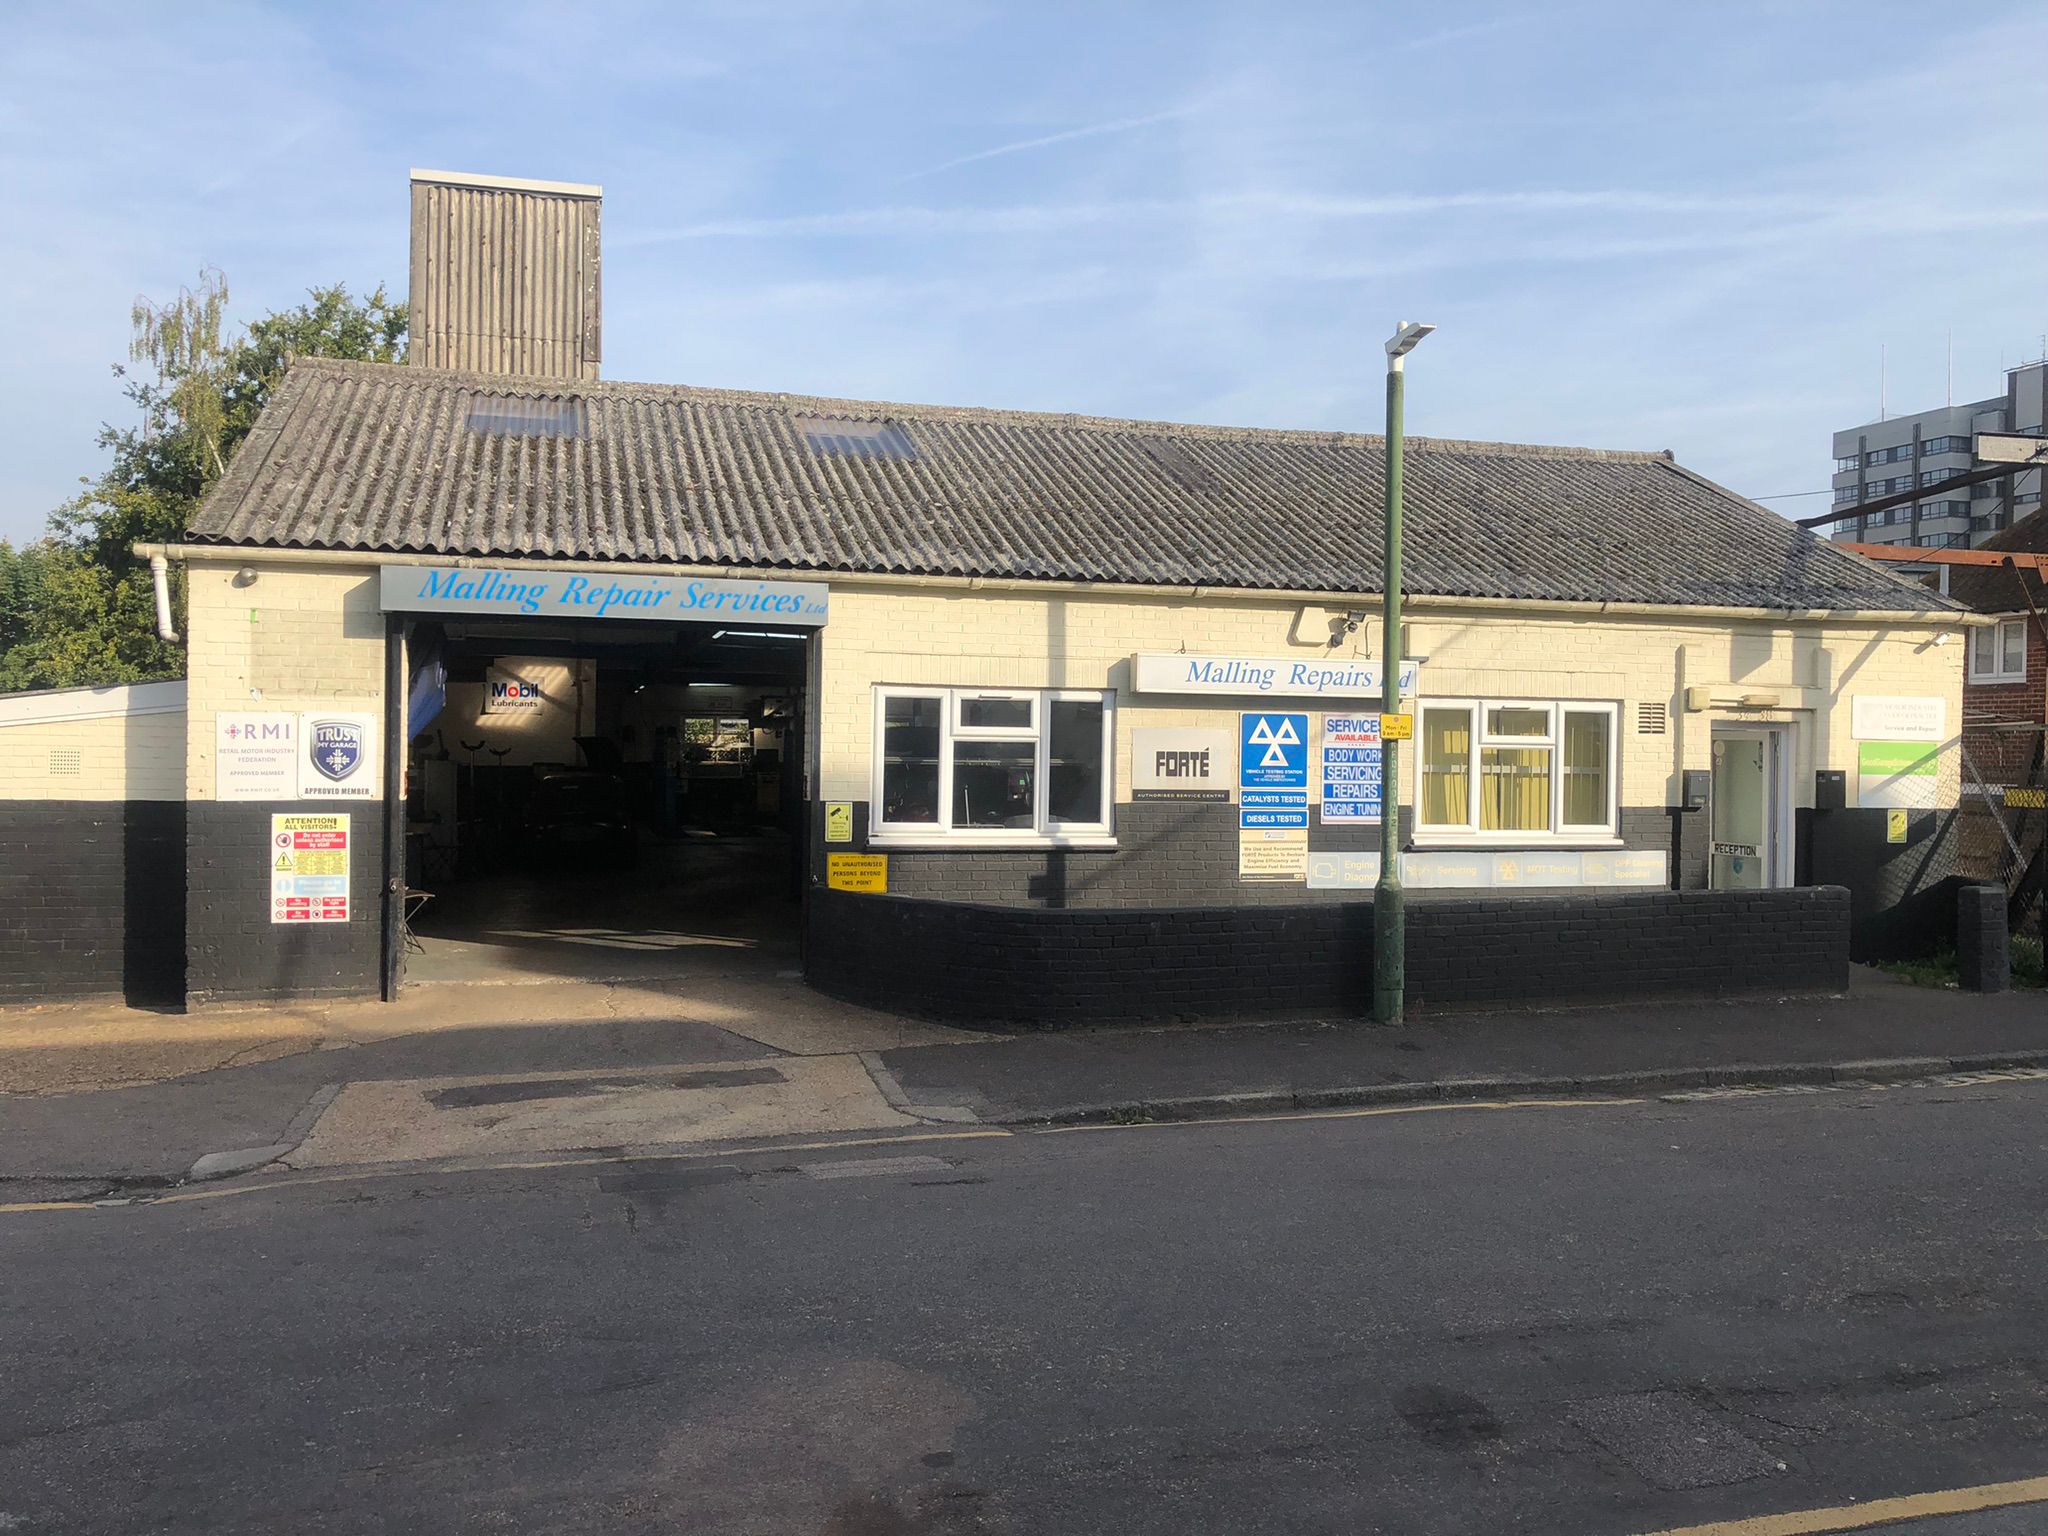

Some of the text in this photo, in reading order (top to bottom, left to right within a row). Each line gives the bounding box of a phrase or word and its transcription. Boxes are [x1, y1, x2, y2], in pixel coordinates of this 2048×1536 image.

[417, 570, 828, 616] Malling Repair Services Ltd
[1185, 660, 1276, 690] Malling
[1288, 663, 1372, 692] Repairs
[492, 682, 538, 698] Mobil
[244, 724, 290, 739] RMI
[318, 728, 358, 741] TRUST
[1334, 734, 1377, 742] AVAILABLE
[1156, 746, 1209, 777] FORTÉ
[1328, 750, 1354, 762] BODY
[1328, 766, 1382, 780] SERVICING
[1332, 784, 1378, 798] REPAIRS
[1324, 803, 1381, 816] ENGINE TUNIN
[1714, 844, 1756, 856] RECEPTION
[1344, 860, 1375, 870] Engine
[1439, 866, 1477, 876] Servicing
[1527, 865, 1578, 875] MOT Testing
[1344, 872, 1379, 883] Diagno
